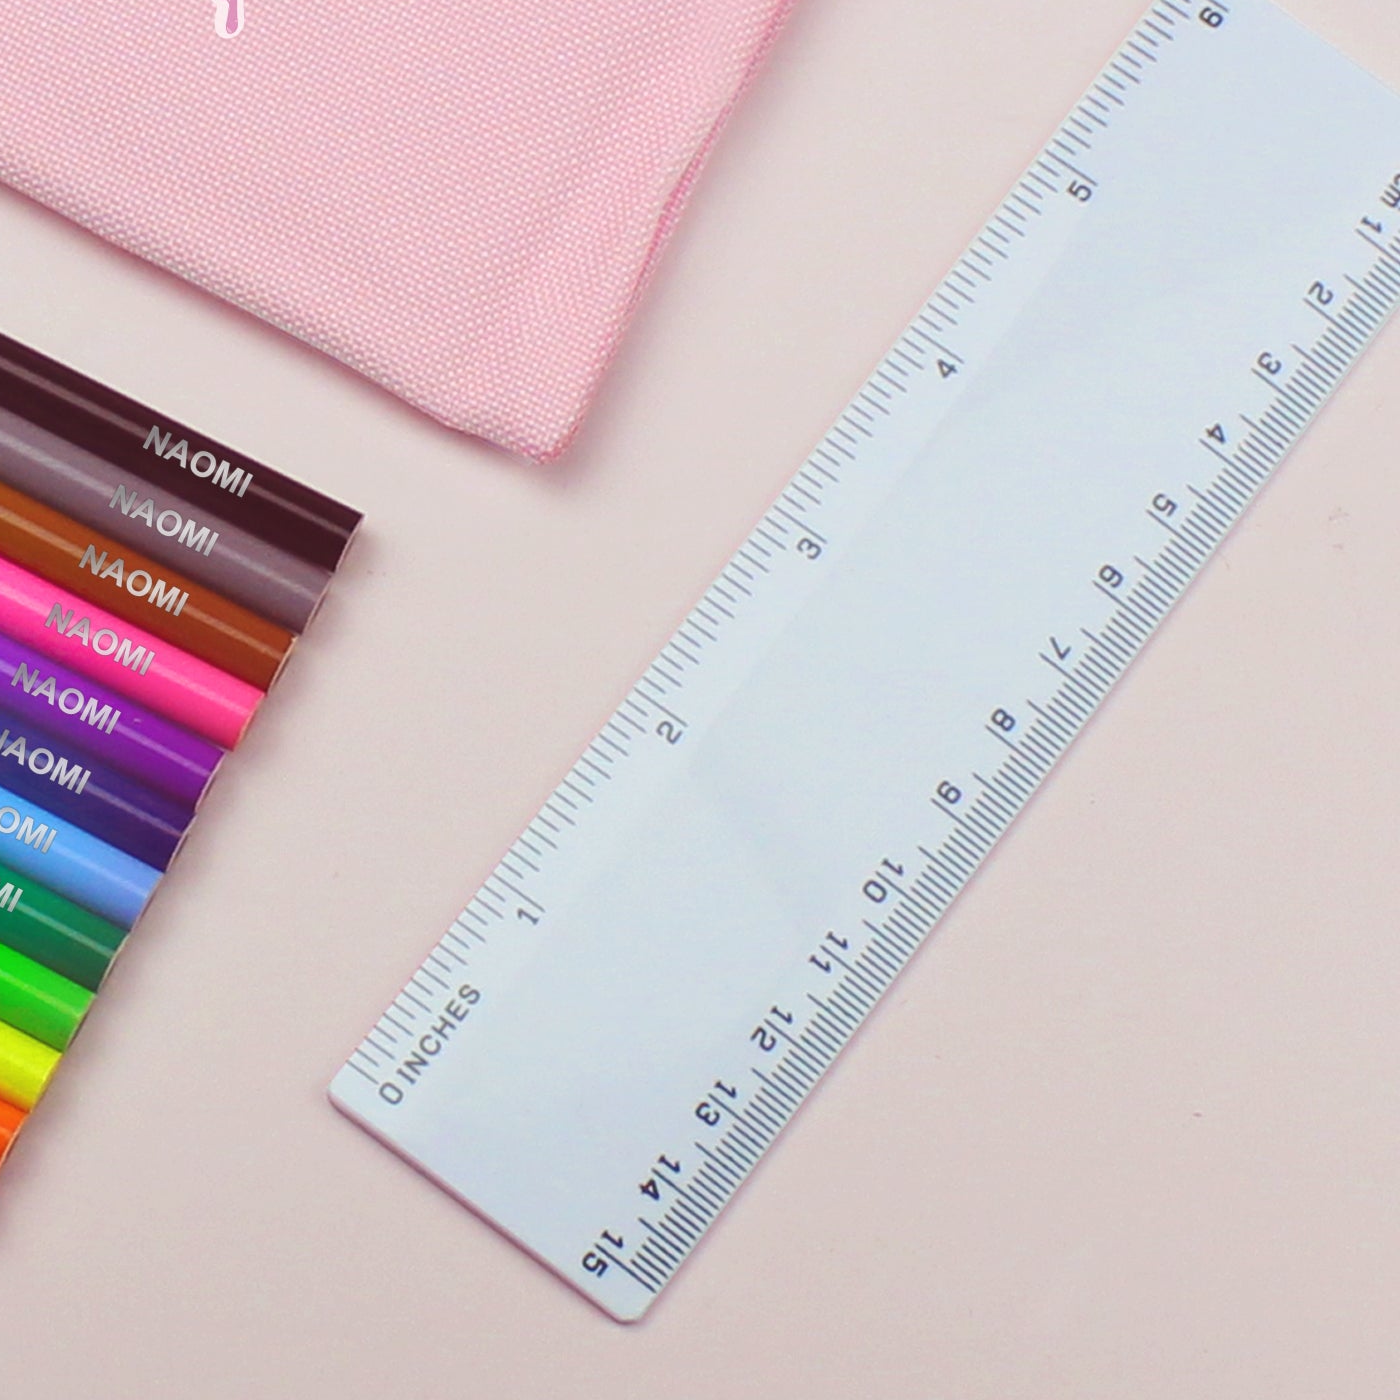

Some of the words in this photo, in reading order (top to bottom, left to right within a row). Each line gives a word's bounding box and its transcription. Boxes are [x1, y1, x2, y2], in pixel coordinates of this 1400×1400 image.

[1360, 215, 1382, 233] 1
[1307, 280, 1334, 306] 2
[1257, 351, 1282, 375] 3
[1204, 422, 1228, 444] 4
[142, 425, 254, 498] NAOMI
[109, 484, 220, 557] NAOMI
[1152, 493, 1179, 518] 5
[378, 1080, 404, 1105] 0
[396, 983, 482, 1085] INCHES
[517, 906, 539, 926] 1
[656, 720, 683, 744] 2
[796, 537, 823, 560] 3
[935, 358, 958, 380] 4
[1067, 180, 1093, 203] 5
[1199, 5, 1225, 29] 6
[1098, 564, 1124, 588] 6
[78, 544, 190, 617] NAOMI
[44, 603, 156, 676] NAOMI
[1049, 636, 1072, 660] 7
[11, 662, 122, 735] NAOMI
[990, 708, 1016, 732] 8
[936, 781, 963, 805] 9
[862, 857, 904, 903] 10
[808, 930, 849, 974] 11
[750, 1004, 794, 1052] 12
[695, 1078, 737, 1127] 13
[637, 1153, 681, 1202] 14
[581, 1230, 624, 1277] 15
